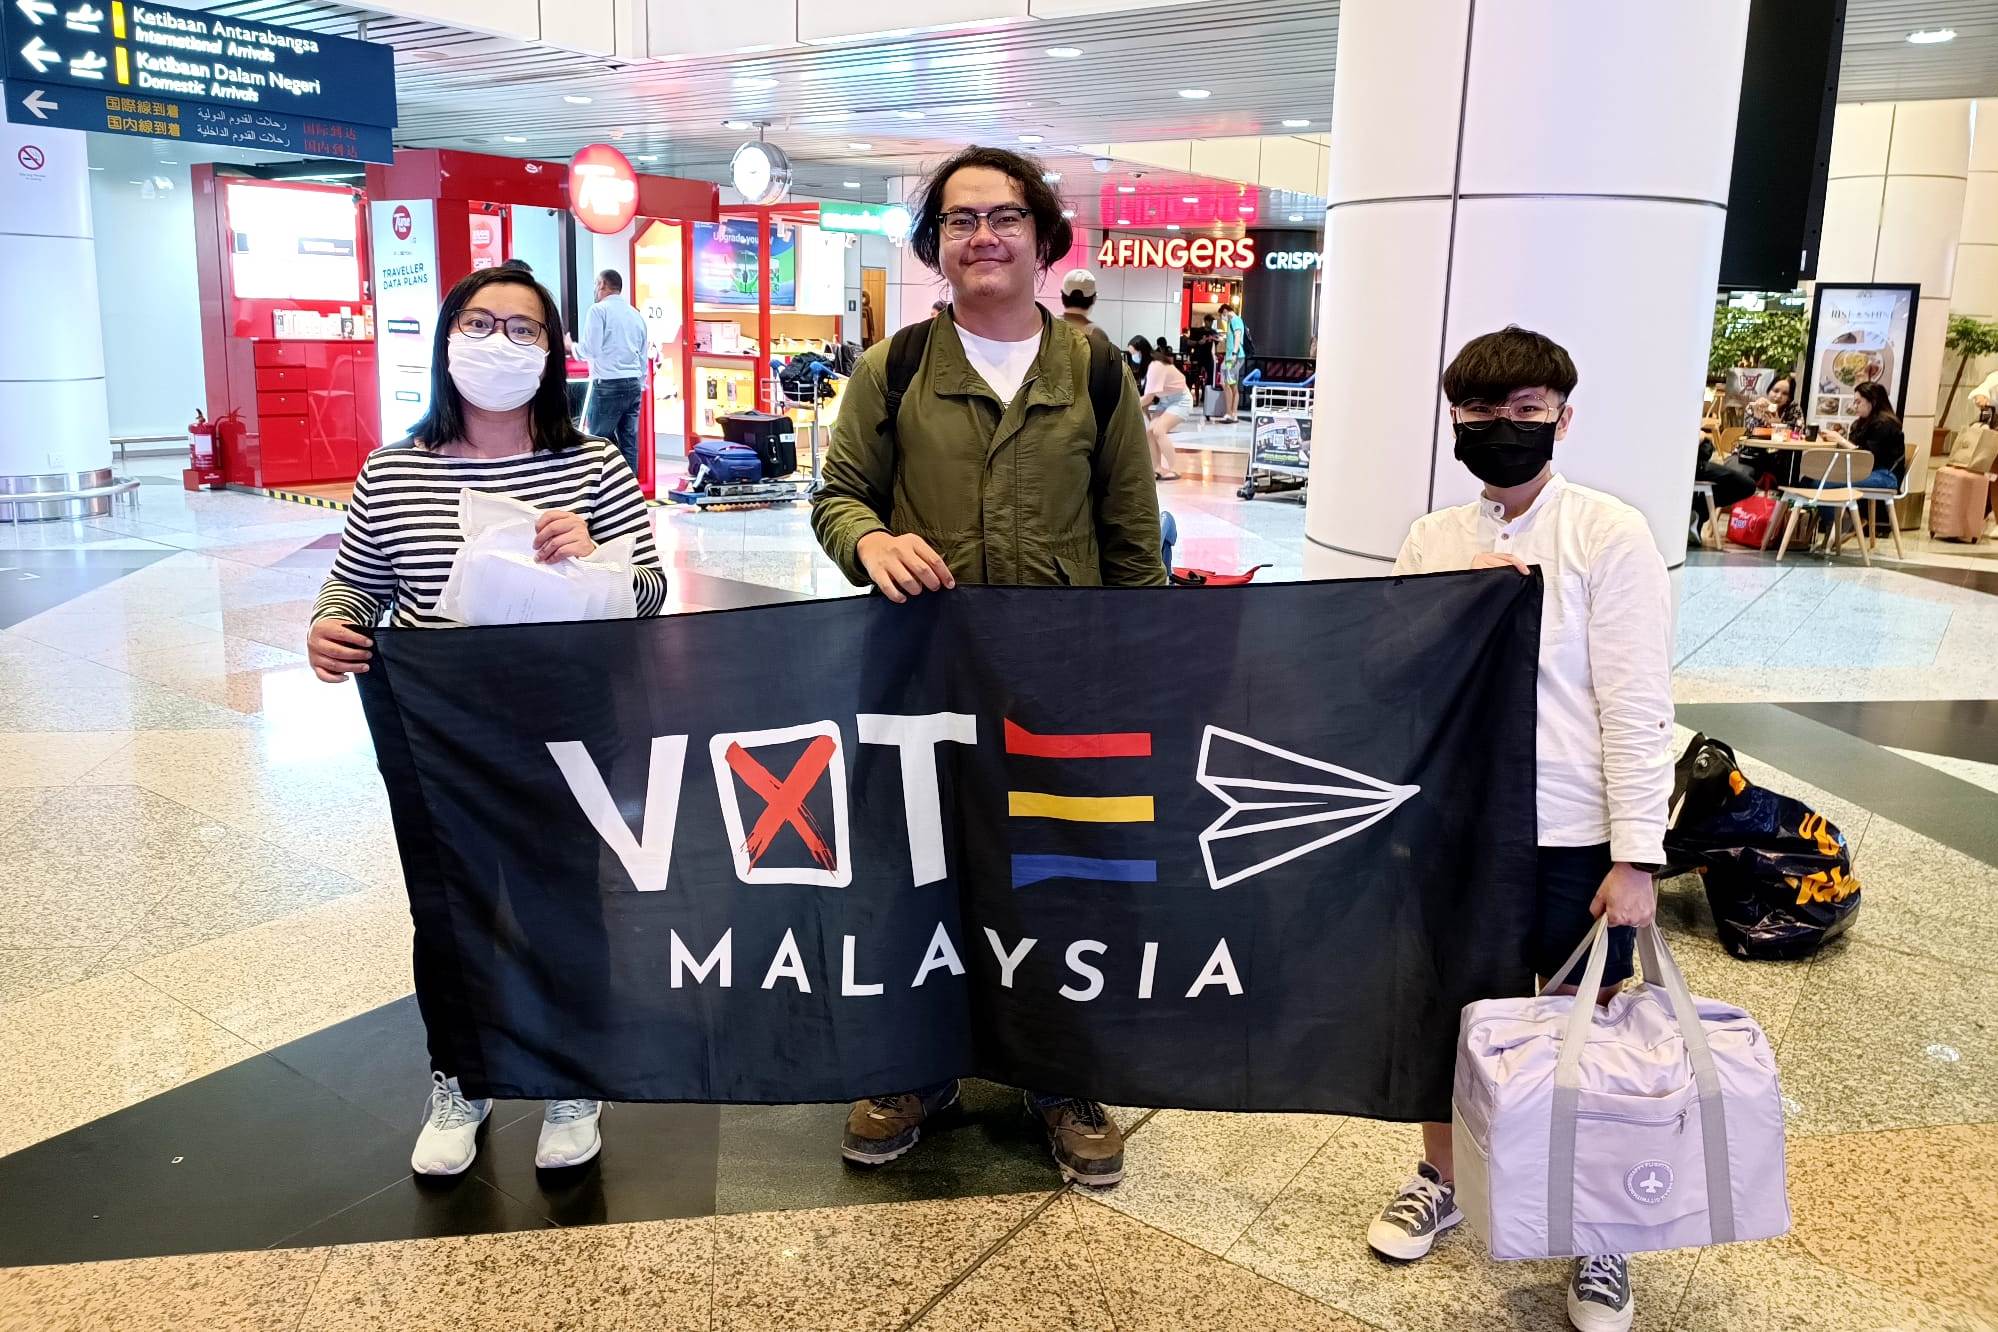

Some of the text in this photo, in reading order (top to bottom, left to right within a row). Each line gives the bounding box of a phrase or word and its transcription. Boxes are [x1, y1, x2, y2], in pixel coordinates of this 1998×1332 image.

[133, 6, 319, 54] Ketibaan Antarabangsa
[227, 42, 275, 63] Arrivals
[136, 51, 320, 95] Ketibaan Dalam Negeri
[139, 72, 258, 102] Domestic Arrivals
[382, 262, 425, 278] TRAVELLER
[1265, 251, 1324, 270] CRISPY
[383, 273, 428, 290] DATA PLANS
[670, 921, 1244, 1001] MALAYSIA
